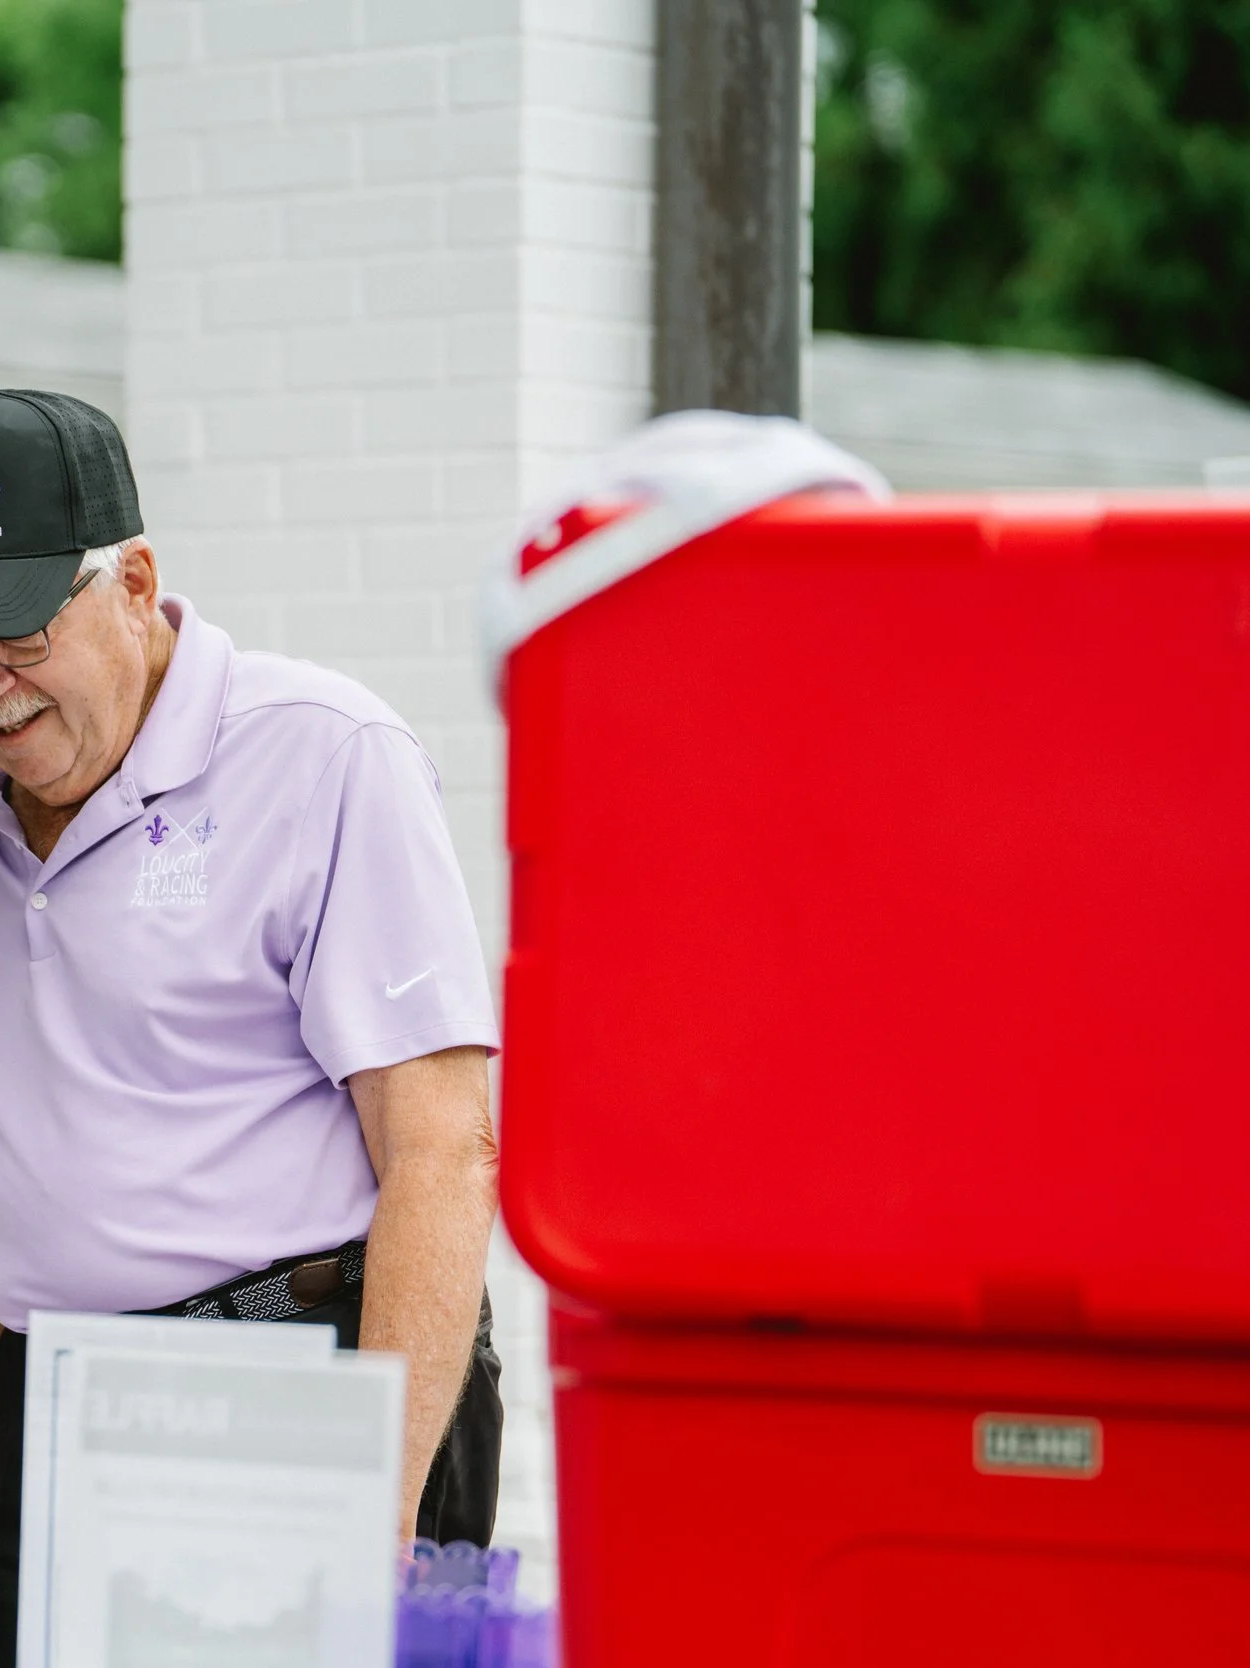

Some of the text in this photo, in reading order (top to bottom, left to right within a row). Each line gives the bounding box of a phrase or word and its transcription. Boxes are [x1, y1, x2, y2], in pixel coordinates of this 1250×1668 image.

[134, 873, 209, 897] & RACING
[130, 895, 206, 907] FOUNDATION
